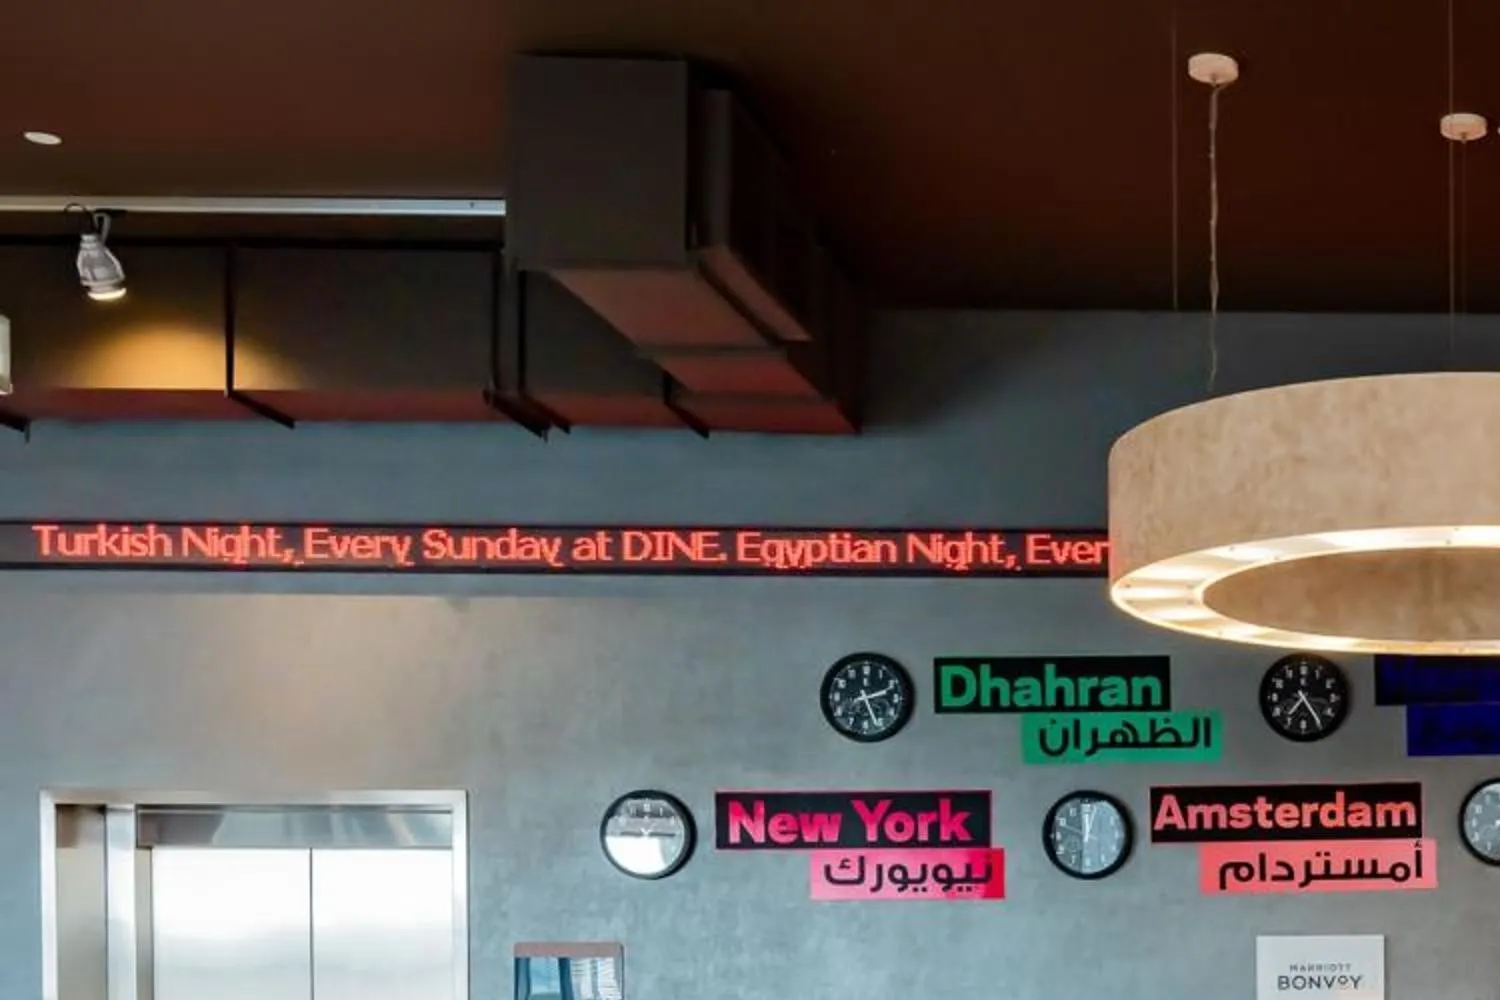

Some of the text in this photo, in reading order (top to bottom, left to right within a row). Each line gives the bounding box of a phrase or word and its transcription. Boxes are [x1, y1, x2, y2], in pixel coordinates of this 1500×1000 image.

[33, 524, 173, 558] Turkish
[304, 528, 415, 566] Every
[422, 528, 564, 567] Sunday
[572, 531, 613, 561] at
[736, 532, 897, 569] Egyptian
[1026, 534, 1108, 564] Ever
[940, 664, 1162, 708] Dhahran
[1039, 715, 1212, 758] الظهران
[727, 799, 972, 844] New York
[1153, 790, 1417, 830] Amsterdam
[824, 855, 994, 892] نيويورك
[1219, 840, 1423, 890] أمستردام
[1289, 962, 1352, 973] MARRIOTT
